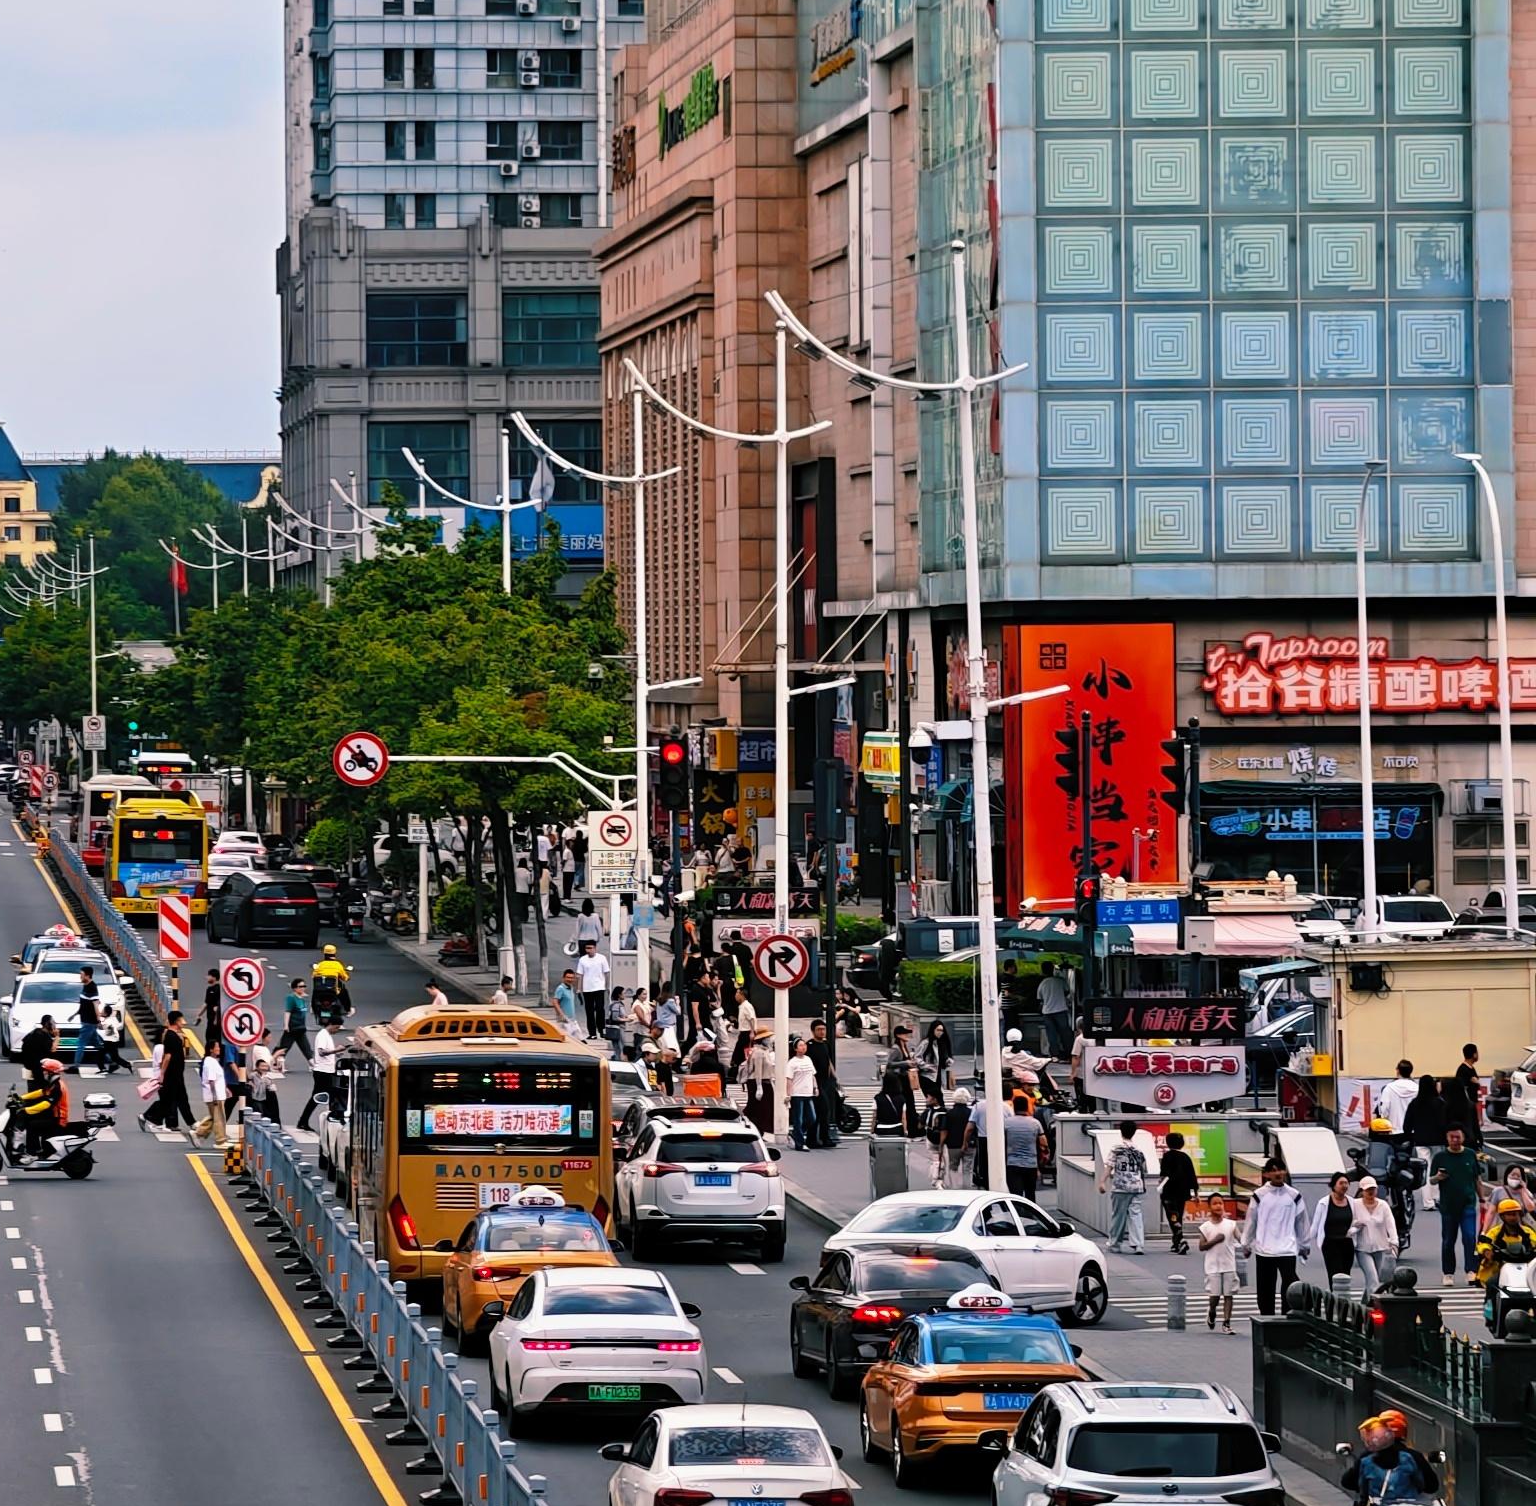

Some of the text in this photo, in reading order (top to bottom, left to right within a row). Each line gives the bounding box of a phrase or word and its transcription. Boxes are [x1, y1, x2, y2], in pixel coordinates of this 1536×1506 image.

[1106, 904, 1170, 916] 石头道街
[1120, 1005, 1238, 1032] 人和新春天
[500, 1109, 562, 1131] 活力哈尔滨
[490, 1188, 510, 1202] 118
